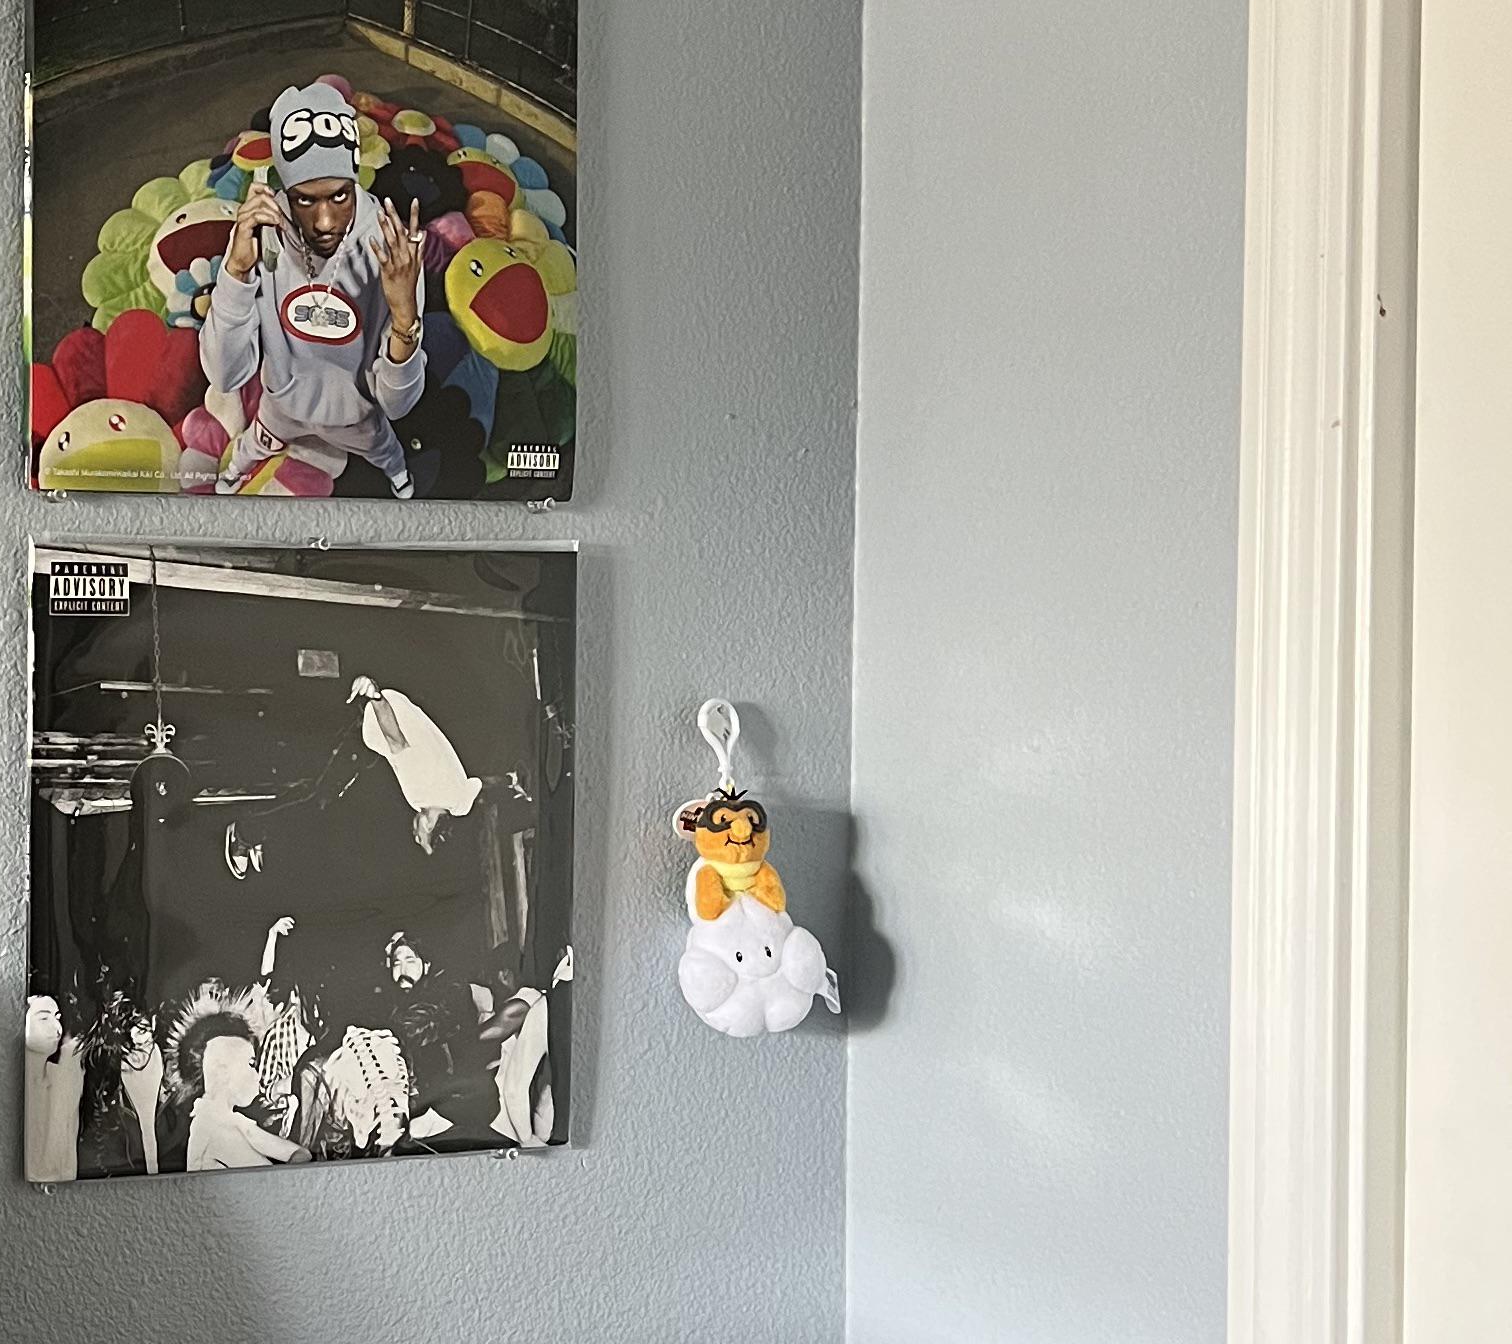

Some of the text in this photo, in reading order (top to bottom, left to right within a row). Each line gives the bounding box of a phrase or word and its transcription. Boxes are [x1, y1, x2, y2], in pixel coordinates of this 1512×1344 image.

[510, 453, 557, 468] ADVISORY
[54, 564, 125, 576] PARENTAL
[53, 577, 126, 597] ADVISORY
[54, 600, 125, 612] EXPLICIT CONTENT
